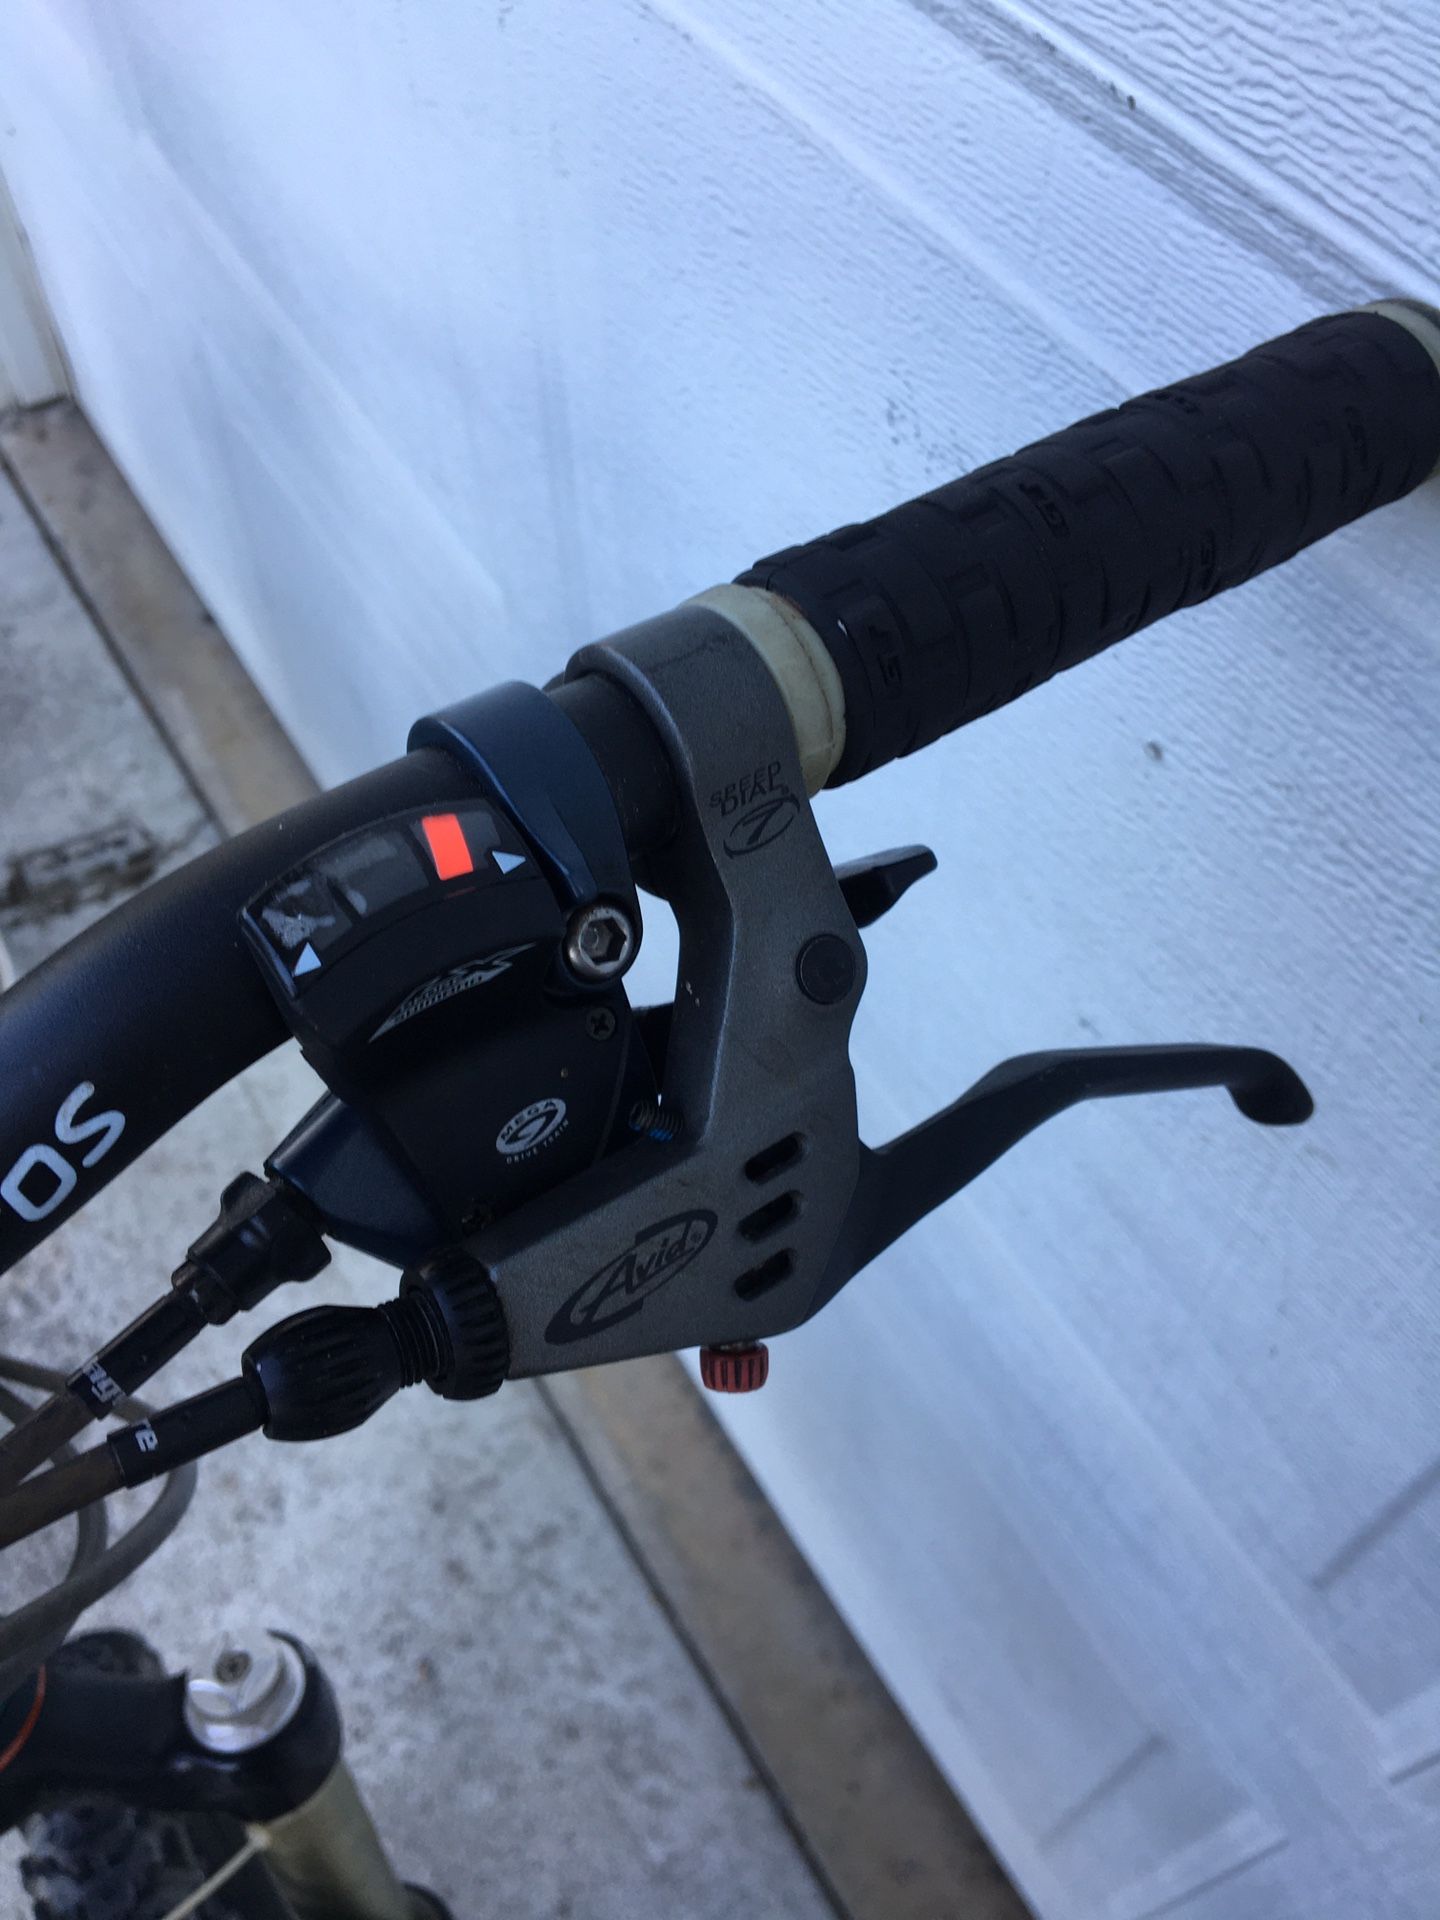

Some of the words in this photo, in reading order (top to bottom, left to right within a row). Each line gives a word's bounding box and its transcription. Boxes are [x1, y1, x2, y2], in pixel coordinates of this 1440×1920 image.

[500, 1100, 557, 1142] MEGA
[506, 1146, 538, 1165] DRIVE
[543, 1118, 569, 1148] TRAIN
[576, 1219, 696, 1326] Avid
